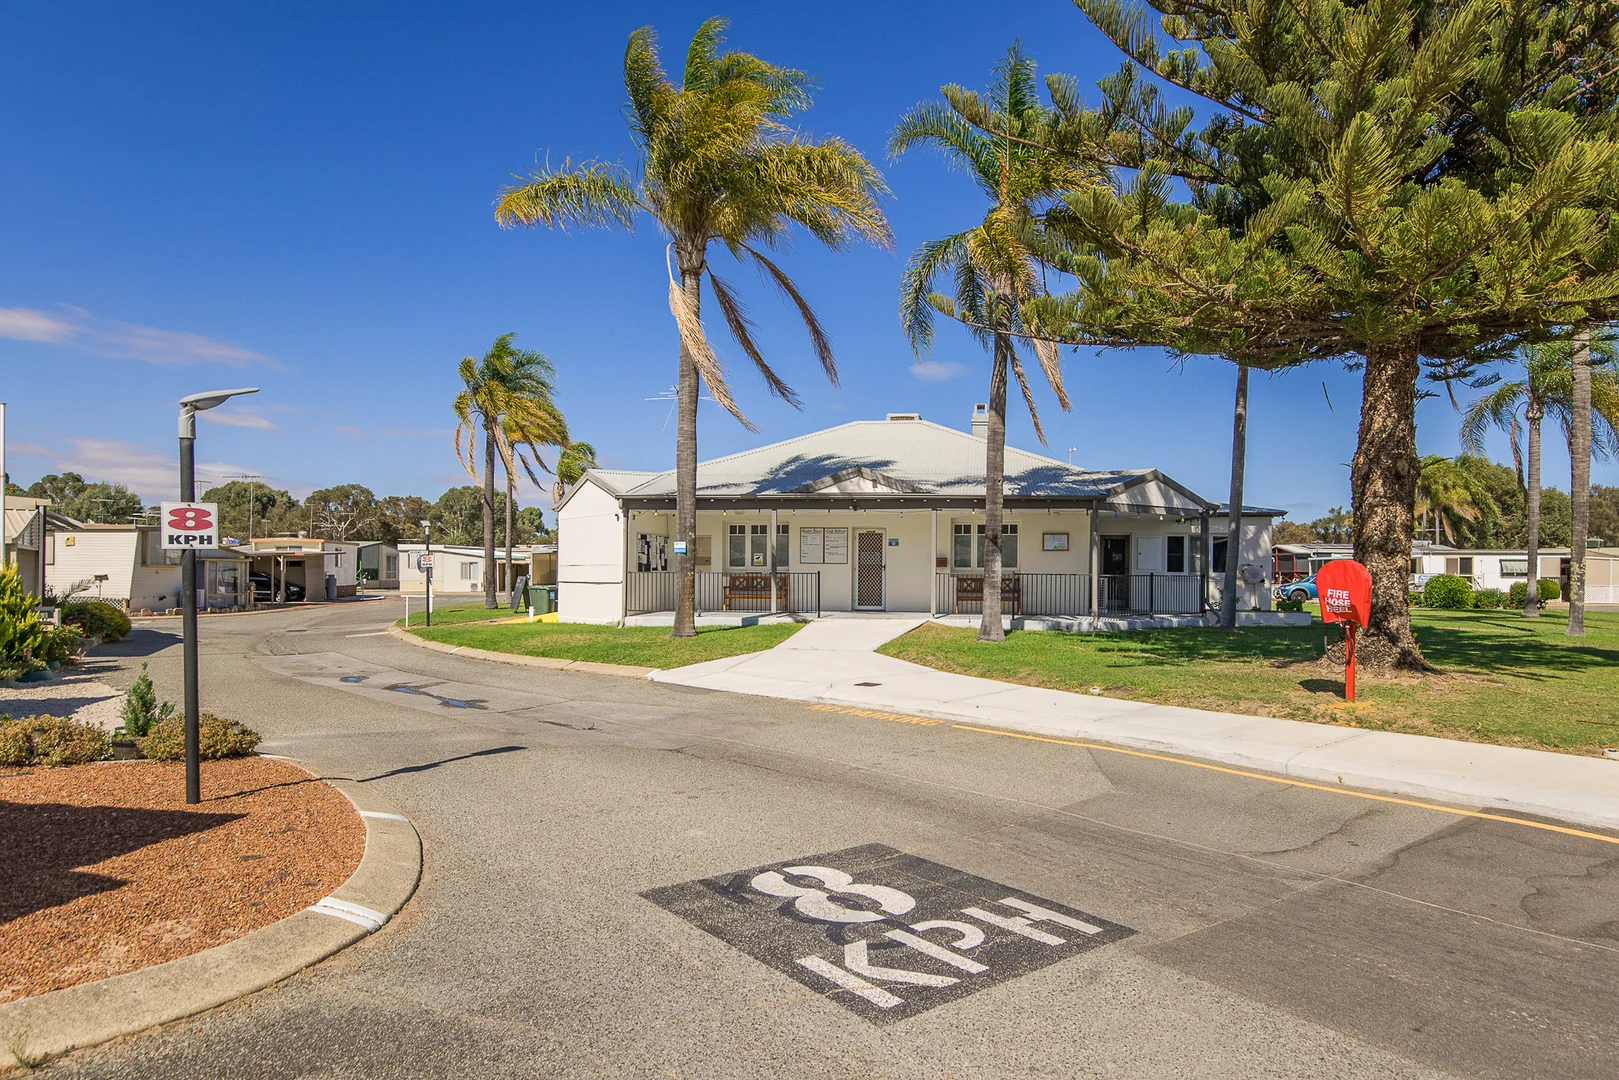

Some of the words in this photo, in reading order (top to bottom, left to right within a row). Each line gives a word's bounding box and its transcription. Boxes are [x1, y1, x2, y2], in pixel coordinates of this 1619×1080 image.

[168, 507, 213, 531] 8
[168, 535, 213, 545] KPH
[1324, 597, 1351, 607] HOSE
[1327, 588, 1349, 599] FIRE
[751, 865, 916, 922] 8
[795, 897, 1104, 1009] KPH
